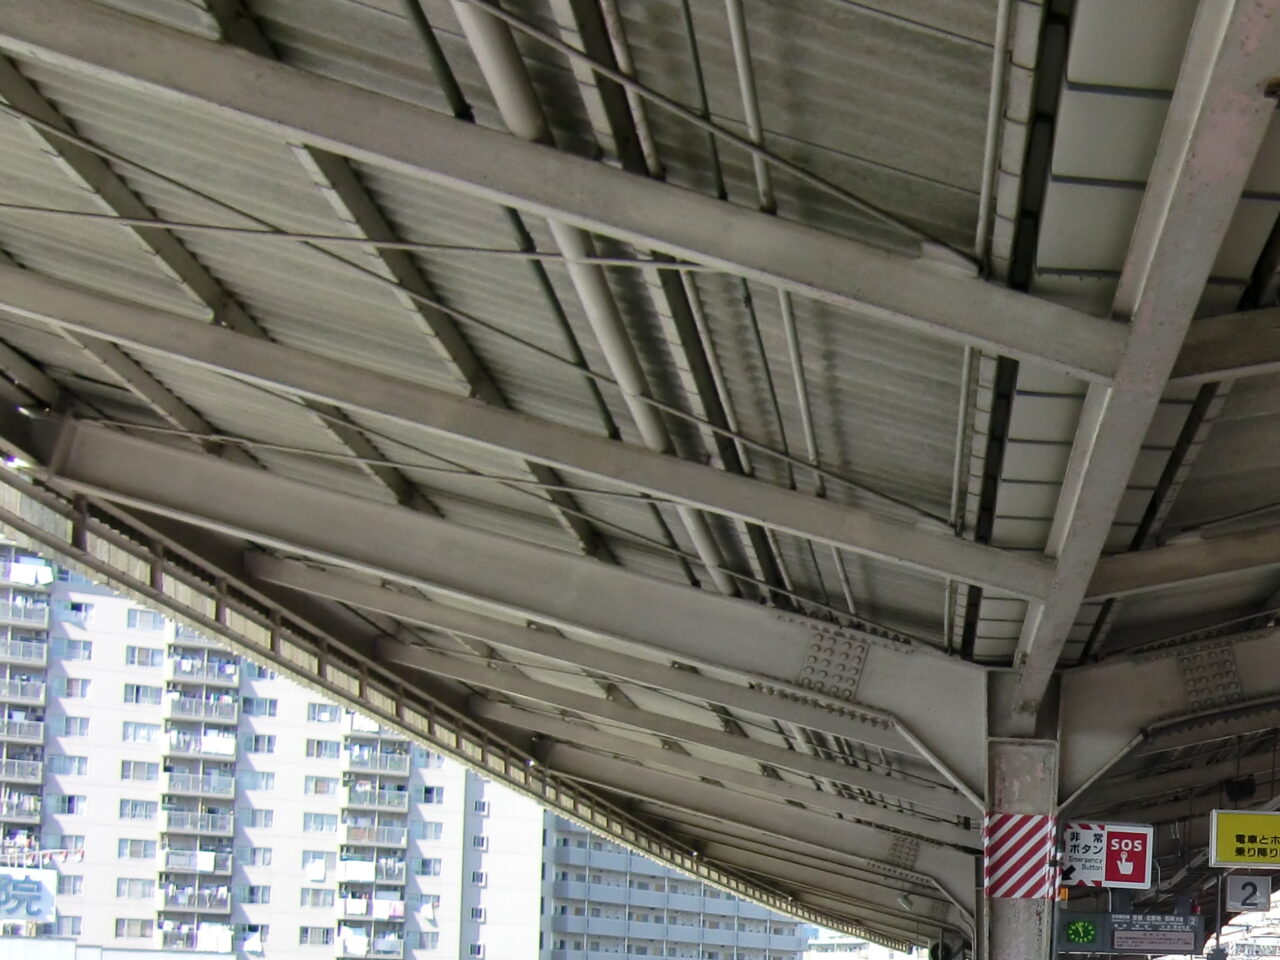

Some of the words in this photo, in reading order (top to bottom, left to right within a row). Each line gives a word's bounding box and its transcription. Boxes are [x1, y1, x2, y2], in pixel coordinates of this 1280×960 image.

[1070, 844, 1103, 855] ボタン
[1110, 839, 1142, 851] SOS
[1068, 855, 1103, 864] Emergency
[1081, 863, 1103, 871] Button
[1240, 881, 1259, 907] 2
